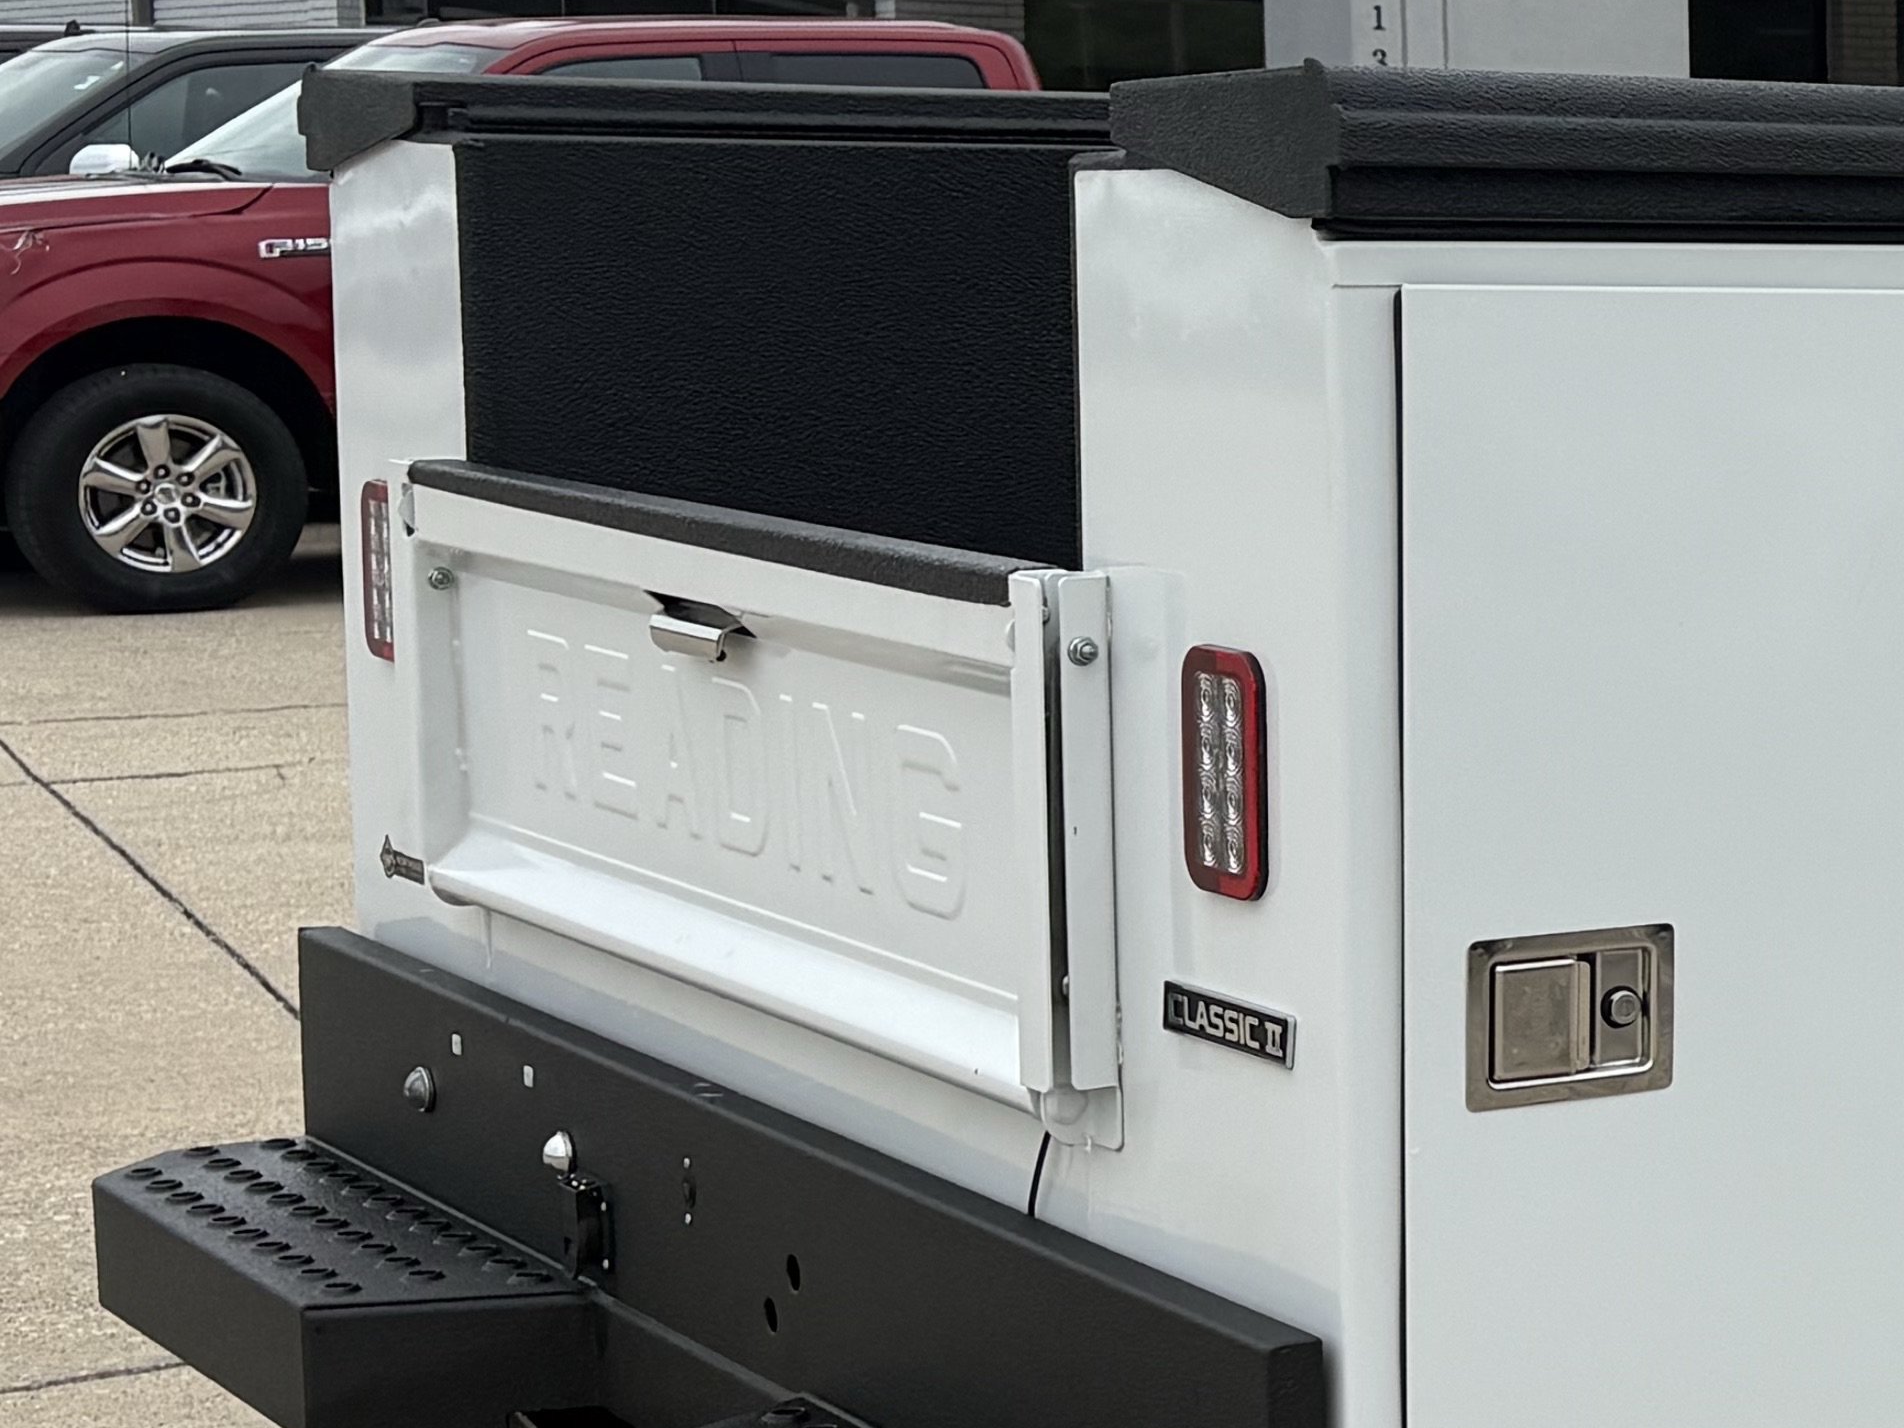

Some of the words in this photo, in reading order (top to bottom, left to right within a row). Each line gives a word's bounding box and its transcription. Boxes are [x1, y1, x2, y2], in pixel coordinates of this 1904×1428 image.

[526, 628, 968, 921] READING
[1167, 992, 1261, 1050] CLASSIC
[1264, 1020, 1284, 1058] II
